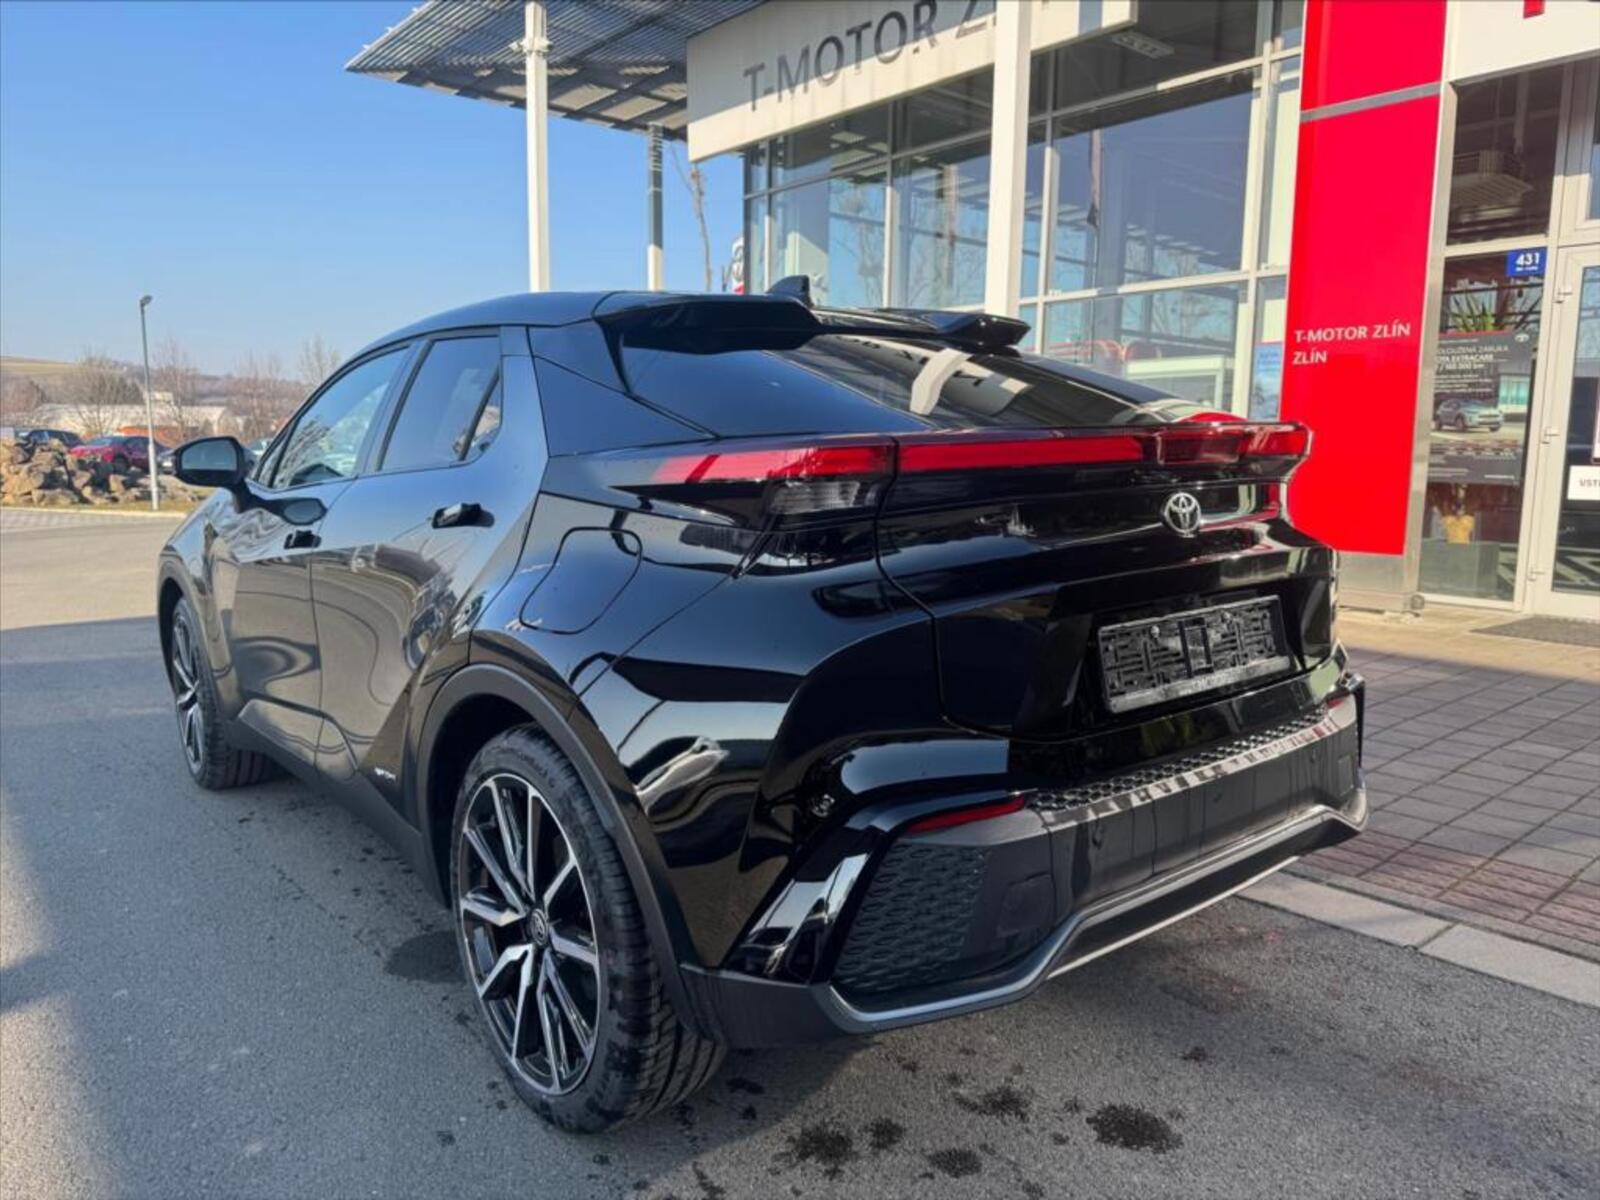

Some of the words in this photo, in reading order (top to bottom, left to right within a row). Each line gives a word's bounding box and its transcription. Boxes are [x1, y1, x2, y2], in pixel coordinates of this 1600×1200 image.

[743, 0, 938, 112] T-MOTOR
[1294, 325, 1368, 343] T-MOTOR
[1372, 319, 1411, 338] ZLÍN
[1293, 347, 1328, 365] ZLÍN
